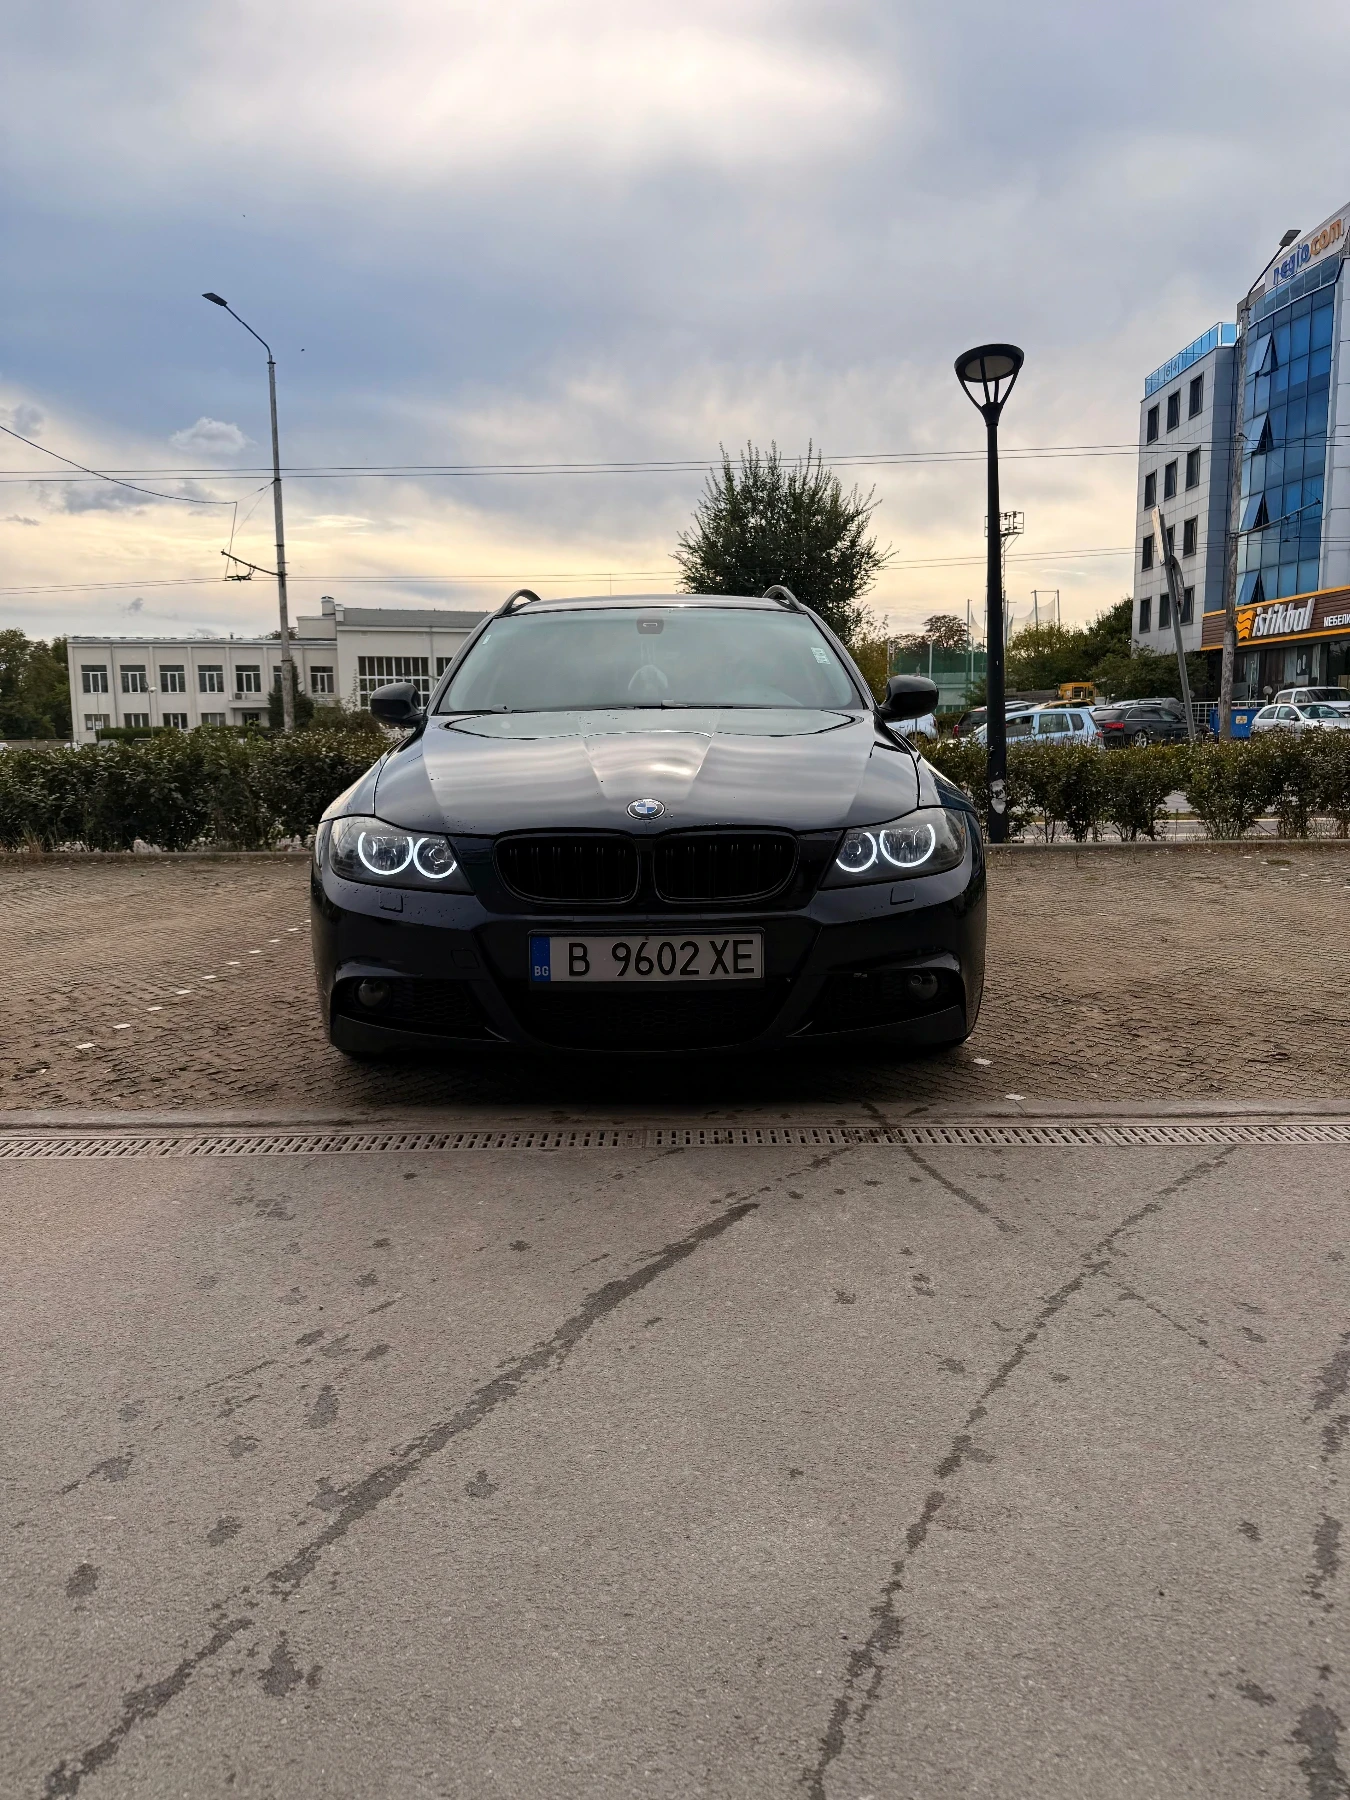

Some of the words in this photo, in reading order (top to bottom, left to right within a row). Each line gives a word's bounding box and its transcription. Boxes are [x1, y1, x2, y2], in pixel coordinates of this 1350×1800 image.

[1252, 598, 1315, 637] istikbal
[534, 965, 549, 977] BG
[568, 942, 590, 977] B
[611, 940, 700, 977] 9602
[708, 939, 755, 975] XE
